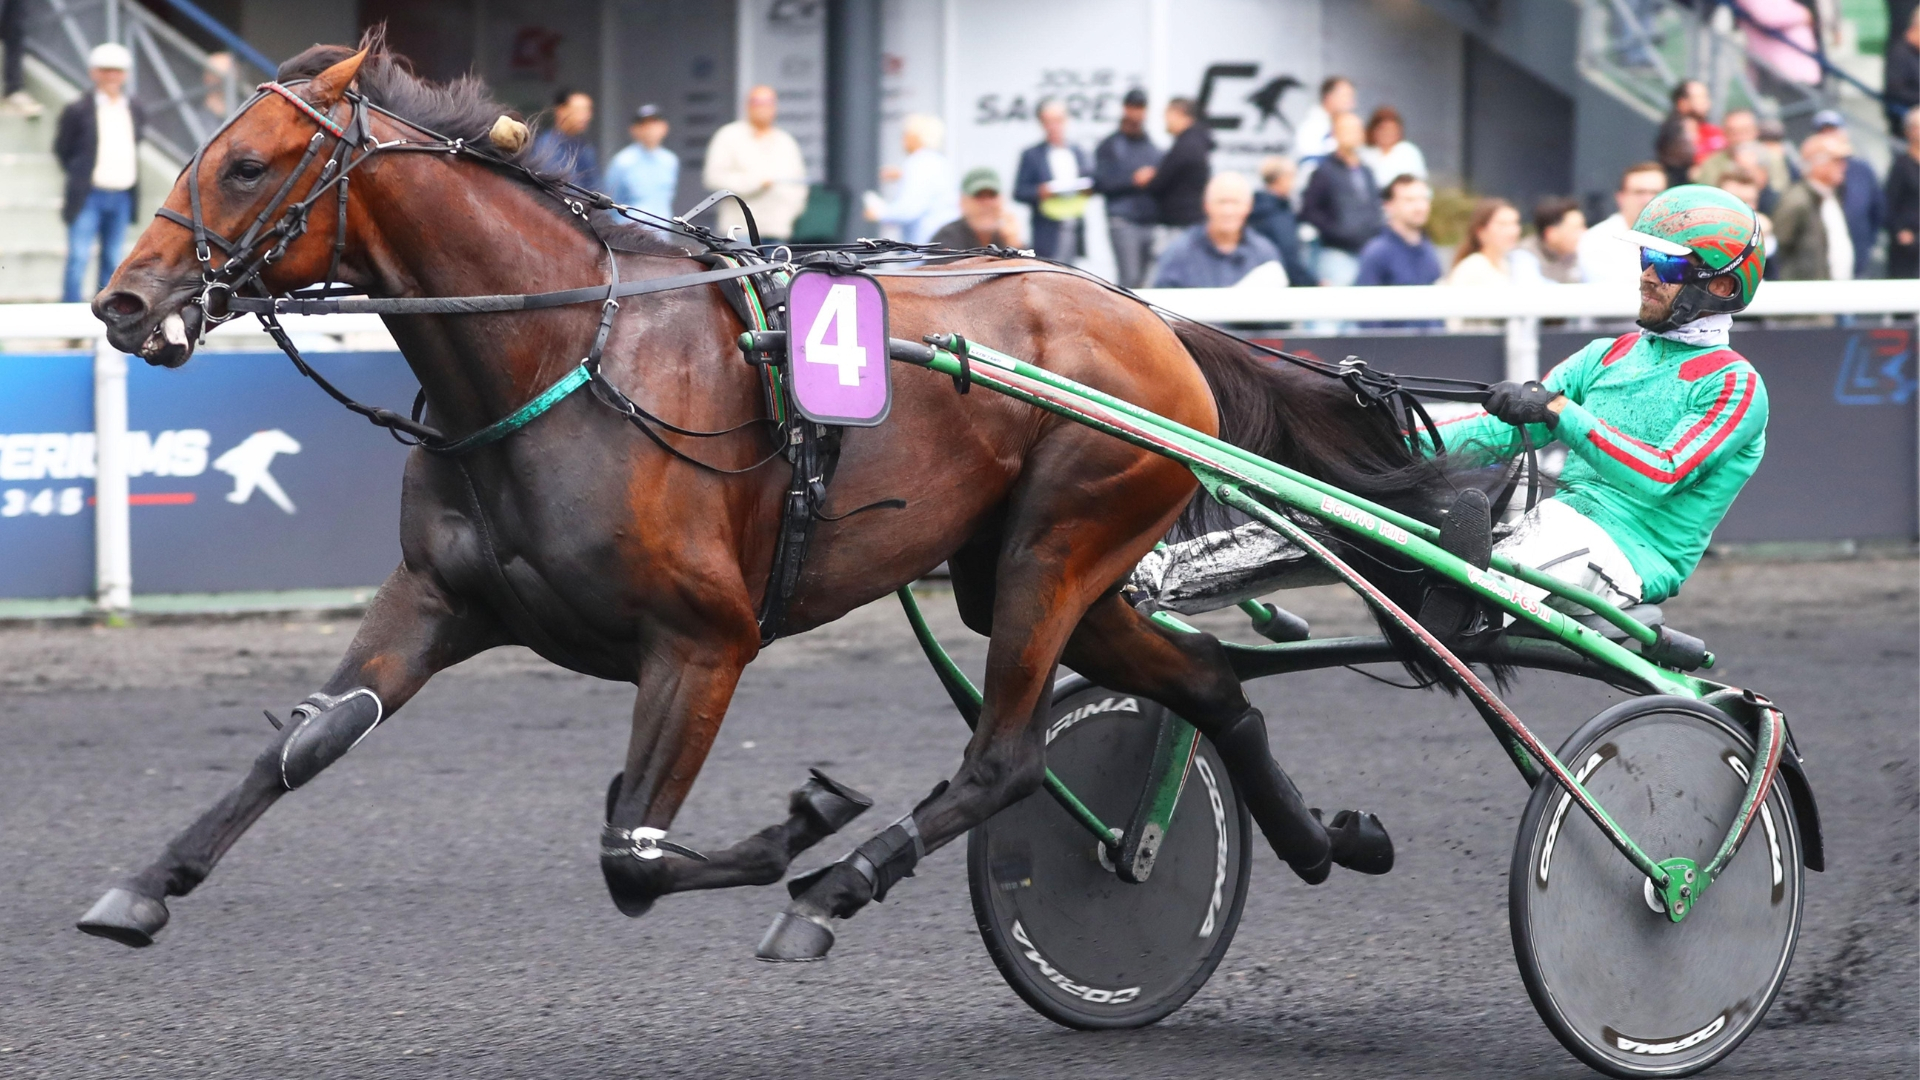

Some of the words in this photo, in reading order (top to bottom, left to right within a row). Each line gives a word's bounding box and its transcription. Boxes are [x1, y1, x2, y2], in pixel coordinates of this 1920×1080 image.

[805, 283, 867, 387] 4
[0, 430, 211, 480] ERIMS
[1321, 495, 1375, 530] Ecurie
[1379, 520, 1408, 545] RIB
[1510, 589, 1540, 615] FCS
[1194, 755, 1228, 938] CORIMA
[1011, 918, 1141, 1005] CORIMA
[1617, 1014, 1726, 1054] CORIMA
